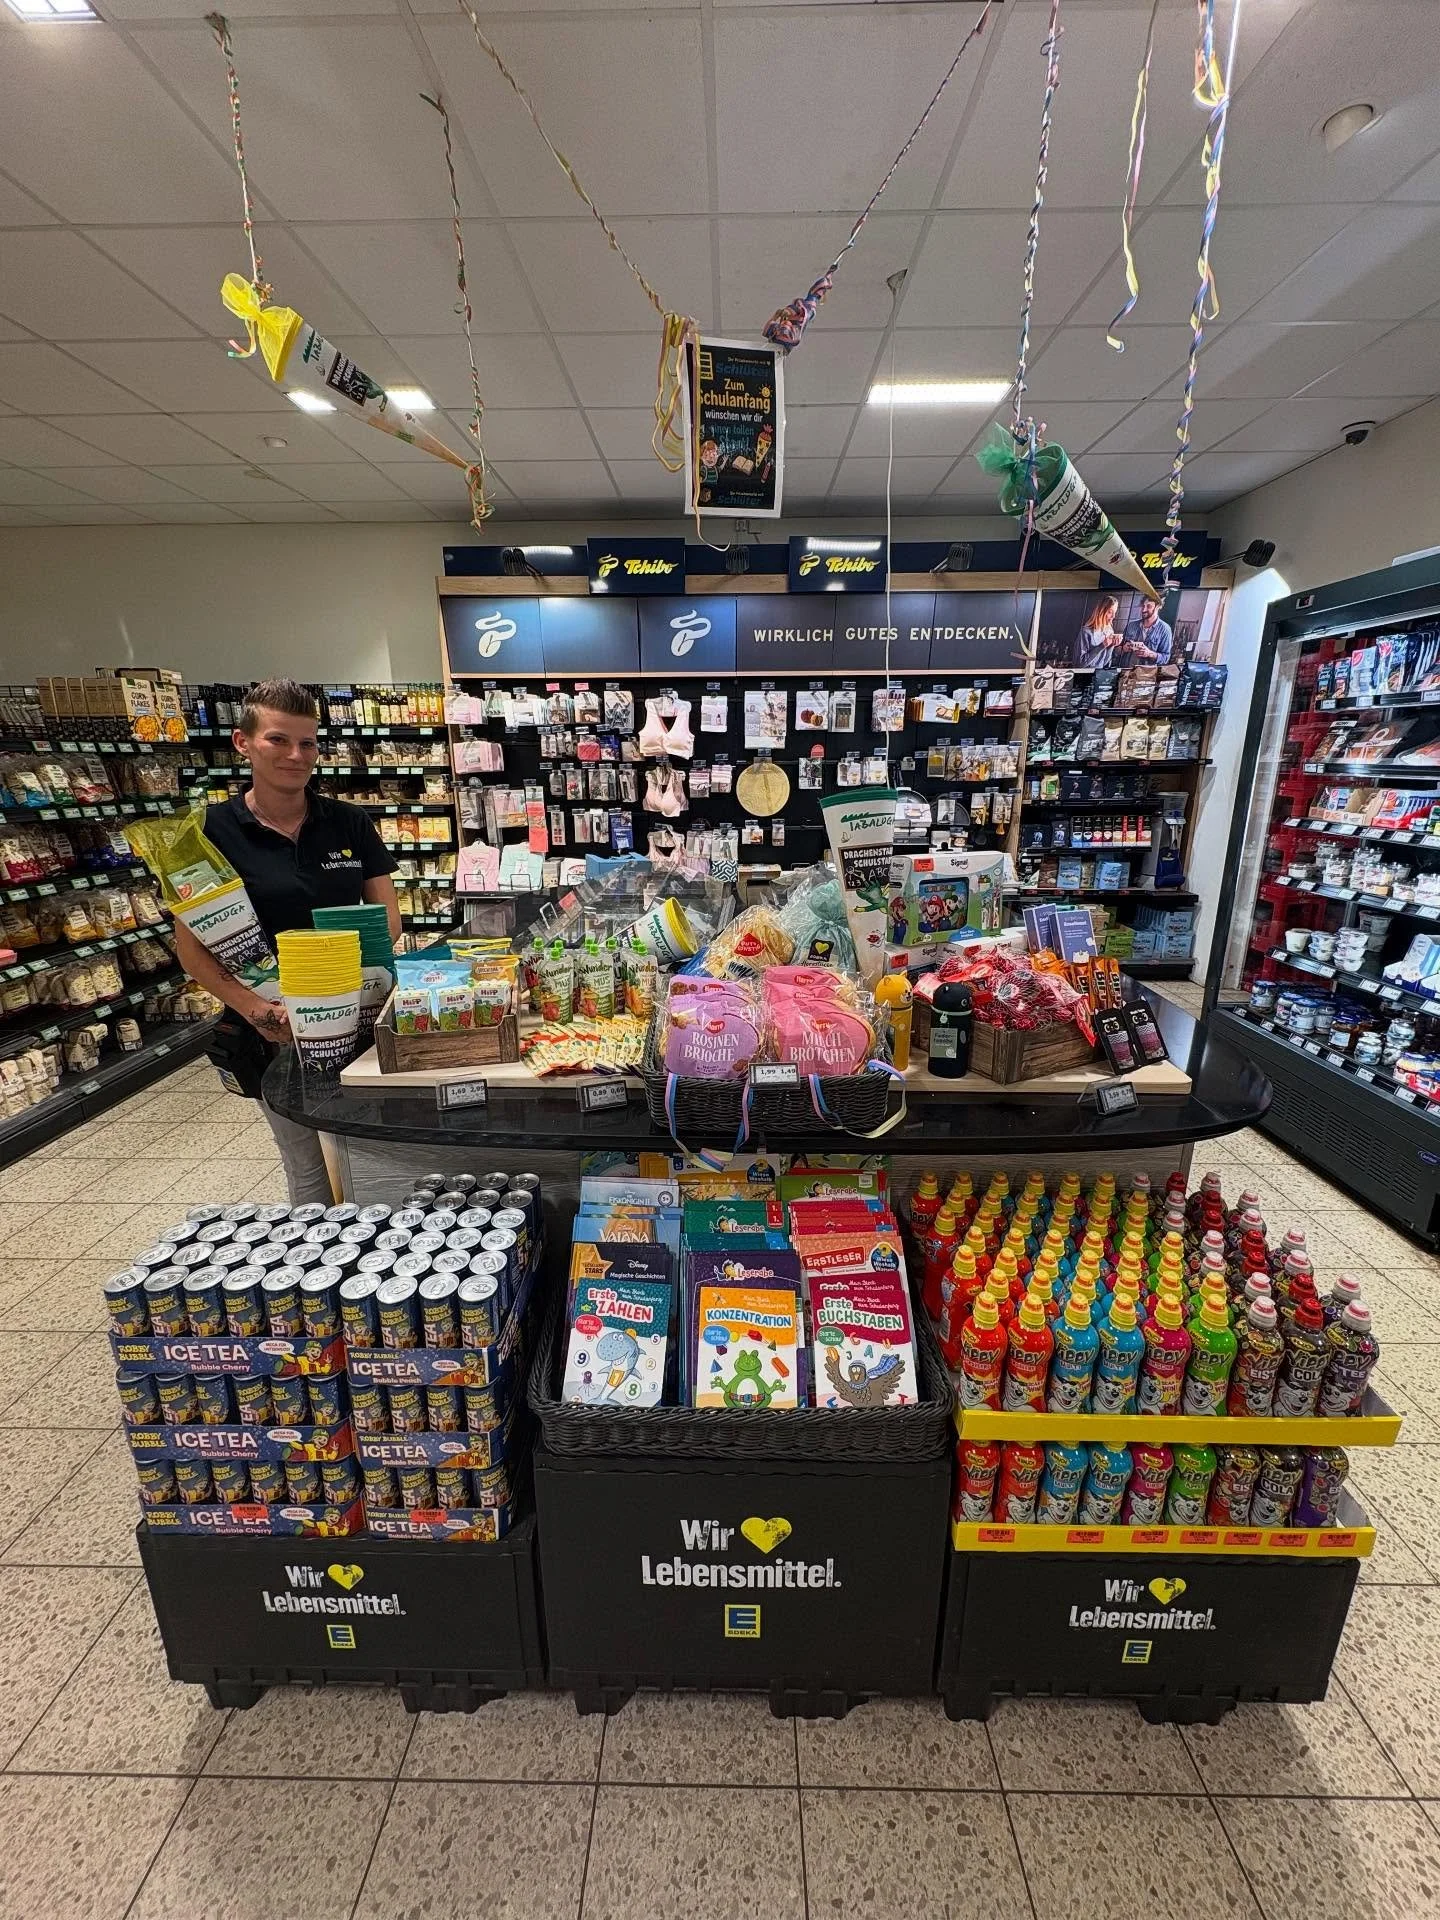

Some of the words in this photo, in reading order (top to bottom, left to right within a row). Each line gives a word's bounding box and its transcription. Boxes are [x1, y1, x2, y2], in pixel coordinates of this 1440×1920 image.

[724, 378, 745, 391] Zum
[705, 409, 740, 421] wünschen
[741, 412, 753, 422] wir
[753, 412, 764, 422] dir
[624, 559, 679, 575] Tchibo
[825, 557, 881, 573] Tchibo
[753, 628, 834, 642] WIRKLICH
[845, 627, 899, 641] GUTES
[909, 626, 1014, 641] ENTDECKEN.
[950, 859, 968, 869] Signal
[196, 904, 245, 933] TABALUGA
[220, 937, 261, 959] SCHULSTART
[580, 960, 612, 975] Wunder
[594, 976, 610, 985] MUS
[304, 1007, 357, 1023] TABALUGA
[692, 1032, 740, 1048] ROSINEN
[802, 1031, 842, 1047] MILCH
[684, 1046, 735, 1062] BRIOCHE
[790, 1046, 856, 1065] BRÖTCHEN
[825, 1187, 857, 1195] Leserabe
[731, 1224, 765, 1233] Leserabe
[628, 1260, 648, 1271] Disney
[807, 1251, 862, 1267] ERSTLESER
[737, 1267, 774, 1277] Leserabe
[589, 1289, 615, 1300] Erste
[598, 1301, 652, 1321] ZAHLEN
[824, 1299, 852, 1309] Erste
[707, 1310, 792, 1326] KONZENTRATION
[819, 1310, 902, 1329] BUCHSTABEN
[118, 1352, 156, 1361] BUBBLE
[164, 1345, 200, 1361] ICE
[202, 1344, 249, 1361] TEA
[577, 1352, 586, 1364] 9
[864, 1345, 873, 1358] A
[222, 1364, 250, 1372] Cherry
[353, 1363, 382, 1375] ICE
[383, 1363, 420, 1376] TEA
[629, 1384, 637, 1394] 8
[130, 1432, 162, 1440] ROBBY
[174, 1432, 210, 1448] ICE
[212, 1431, 257, 1448] TEA
[131, 1440, 167, 1448] BUBBLE
[231, 1450, 259, 1459] Cherry
[362, 1446, 391, 1457] ICE
[392, 1446, 427, 1457] TEA
[1261, 1478, 1294, 1495] COLA
[147, 1518, 181, 1526] BUBBLE
[190, 1512, 226, 1526] ICE
[370, 1520, 397, 1532] ICE
[398, 1523, 432, 1533] TEA
[245, 1527, 272, 1535] Cherry
[680, 1519, 735, 1550] Wir
[285, 1565, 324, 1588] Wir
[642, 1555, 842, 1588] Lebensmittel.
[1105, 1579, 1144, 1603] Wir
[262, 1591, 408, 1615] Lebensmittel.
[1069, 1606, 1216, 1630] Lebensmittel.
